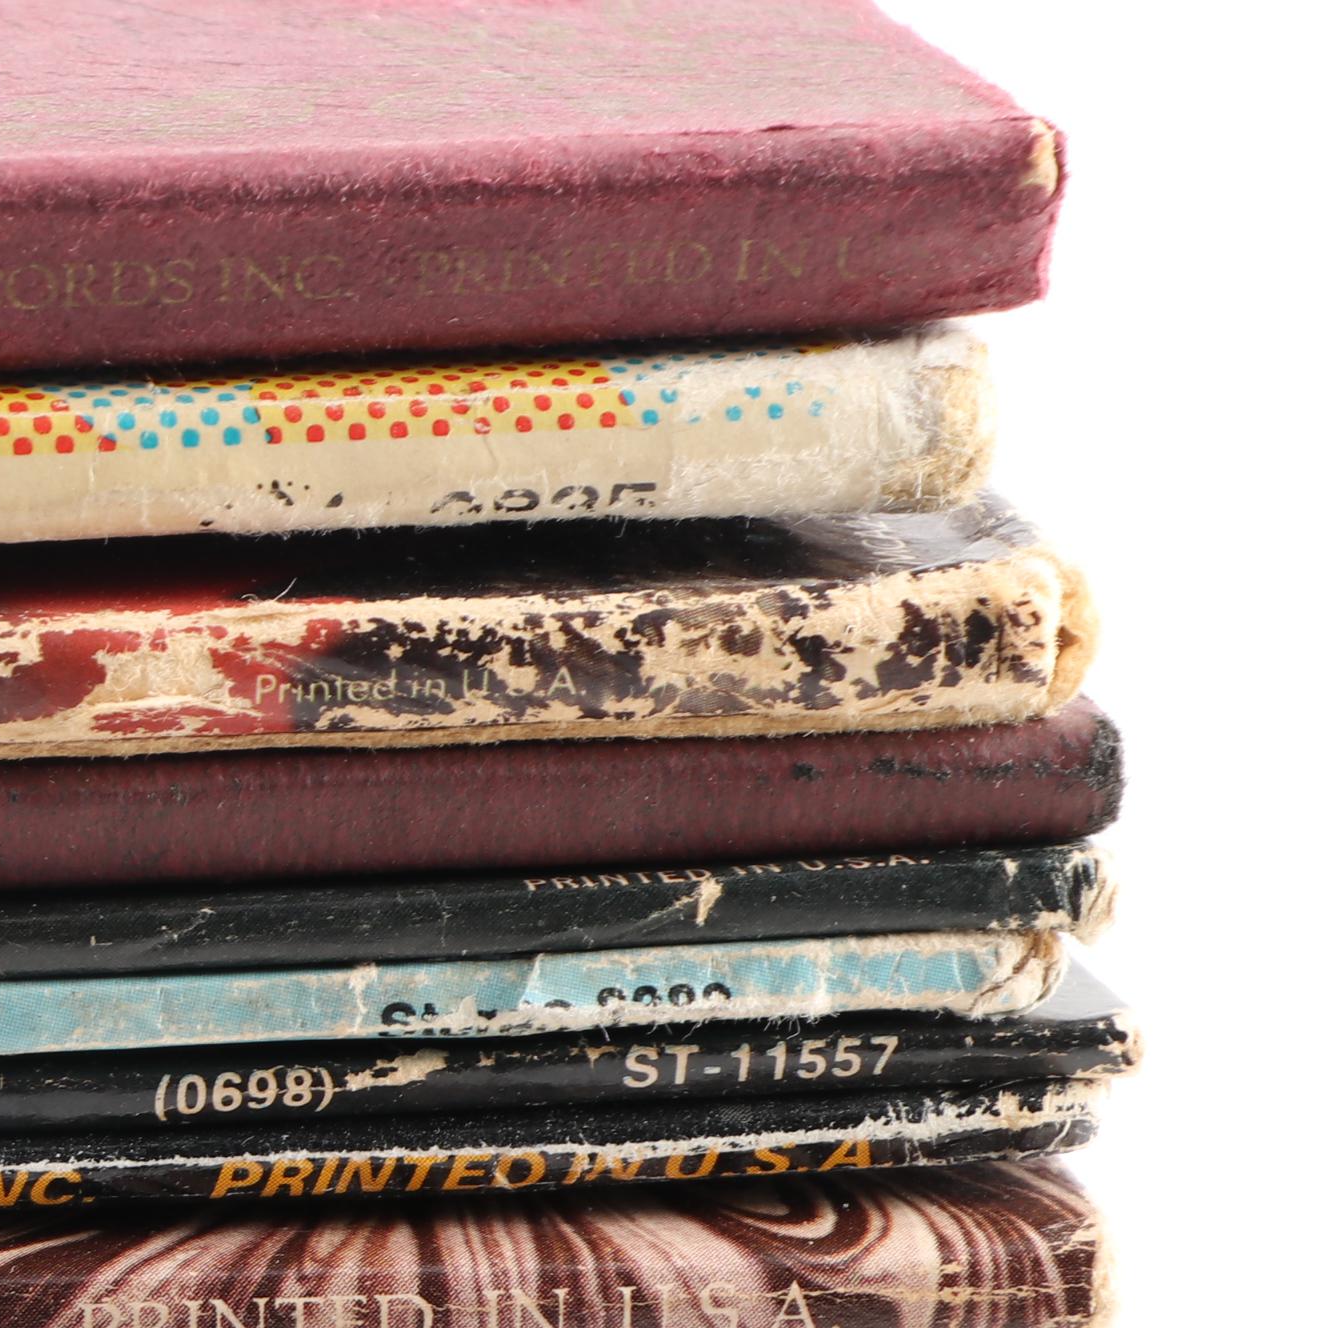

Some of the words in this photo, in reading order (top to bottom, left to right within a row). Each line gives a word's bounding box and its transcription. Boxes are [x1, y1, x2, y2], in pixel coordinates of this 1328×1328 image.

[413, 241, 714, 297] PRINTED
[736, 237, 810, 285] IN
[253, 668, 398, 706] Printed
[410, 669, 448, 700] in
[523, 867, 712, 893] PRINTED
[797, 853, 931, 873] U.S.A.
[153, 1067, 338, 1123] (0698)
[621, 1034, 899, 1089] ST-11557
[209, 1152, 546, 1200] PRINTED
[561, 1151, 642, 1186] IN
